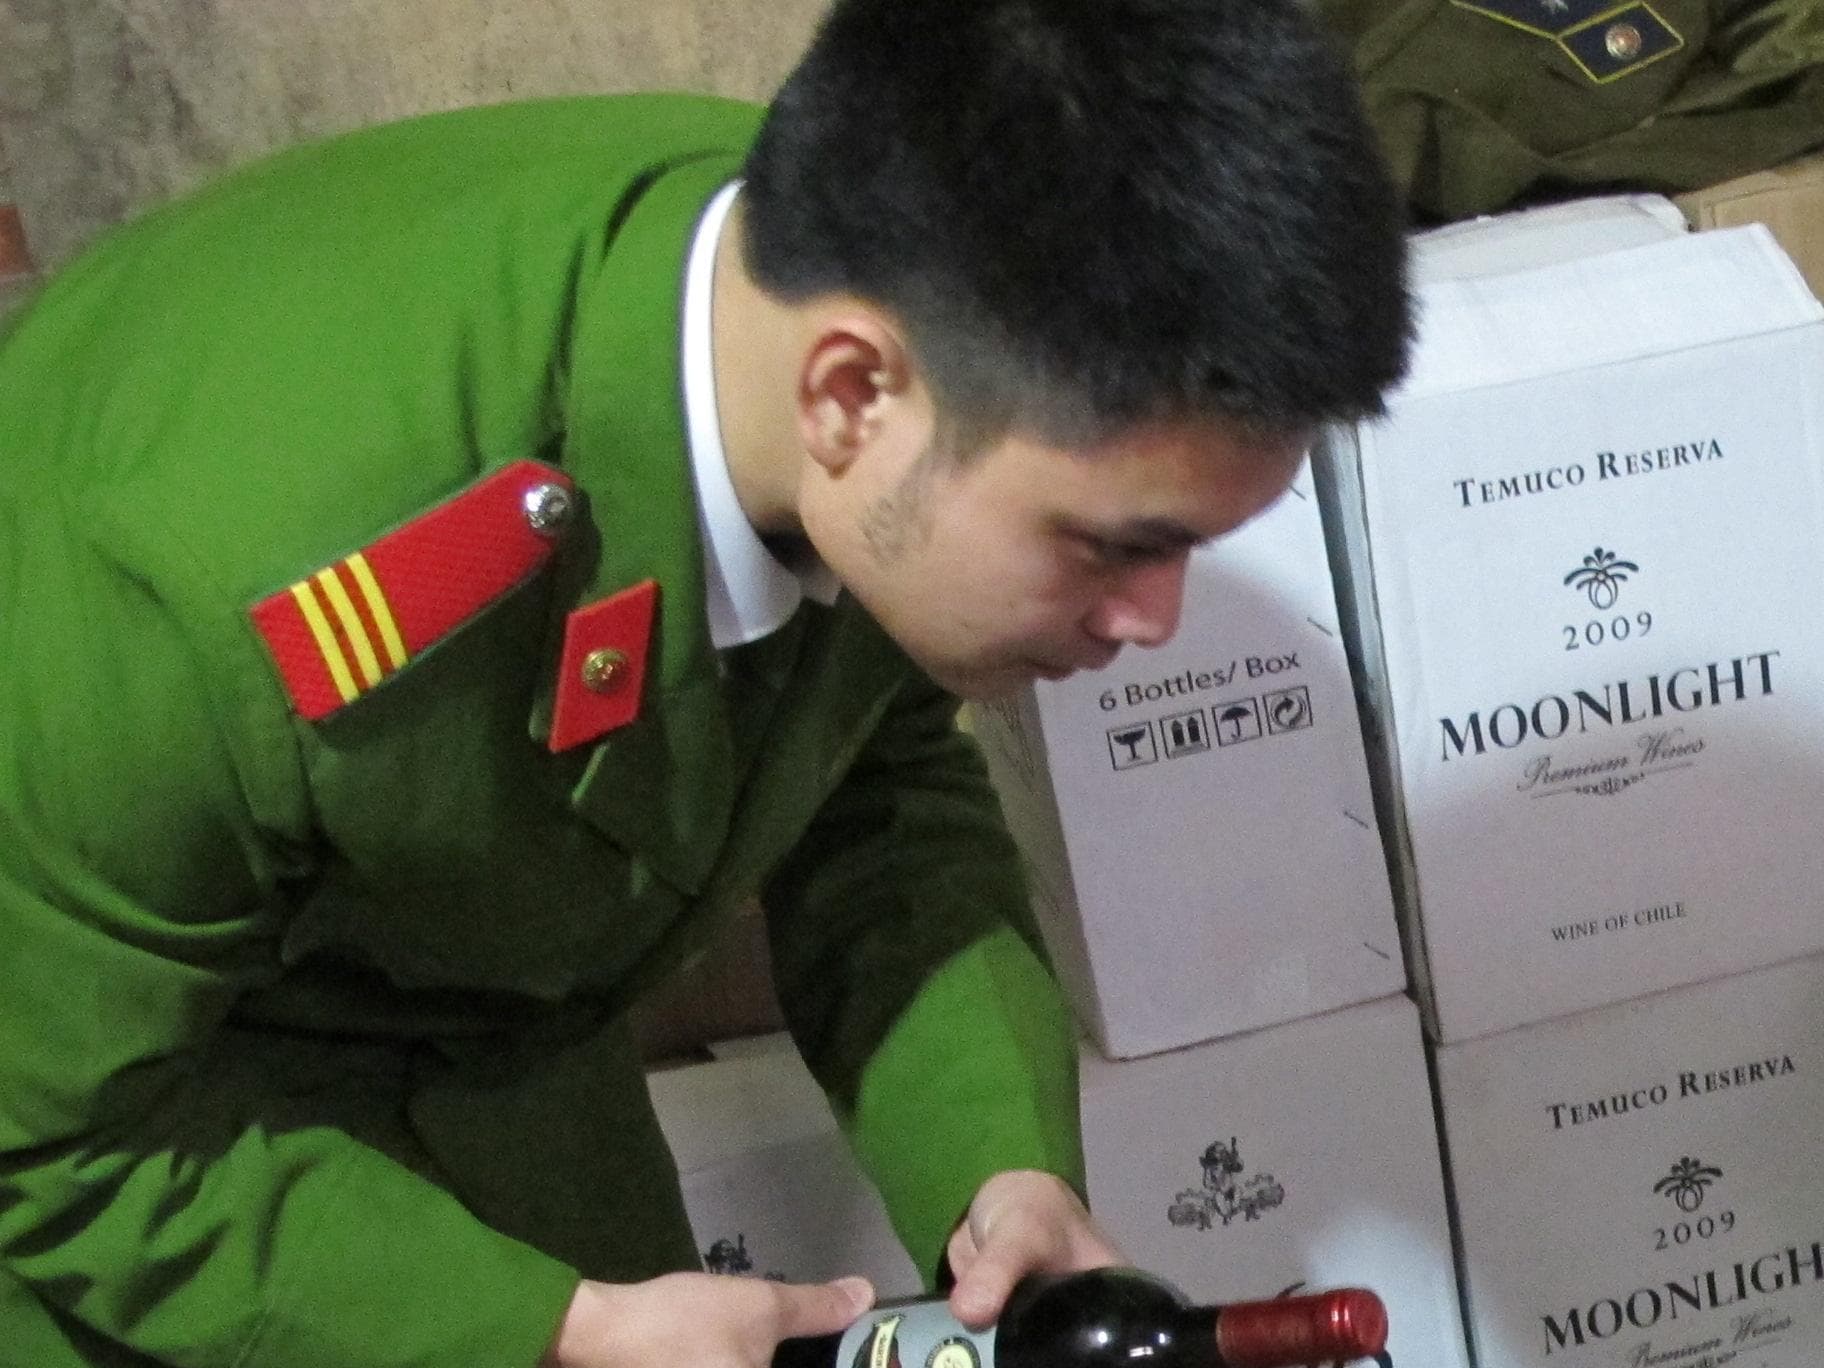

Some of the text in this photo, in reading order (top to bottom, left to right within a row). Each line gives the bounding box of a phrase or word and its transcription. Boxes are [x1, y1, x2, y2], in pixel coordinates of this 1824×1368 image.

[1562, 610, 1653, 651] 2009
[1100, 651, 1301, 712] 6 Bottles/ Box
[1438, 650, 1781, 762] MOONLIGHT
[1516, 726, 1707, 793] Premium Wines
[1551, 901, 1688, 942] WINE OF CHILE
[1653, 1210, 1736, 1251] 2009
